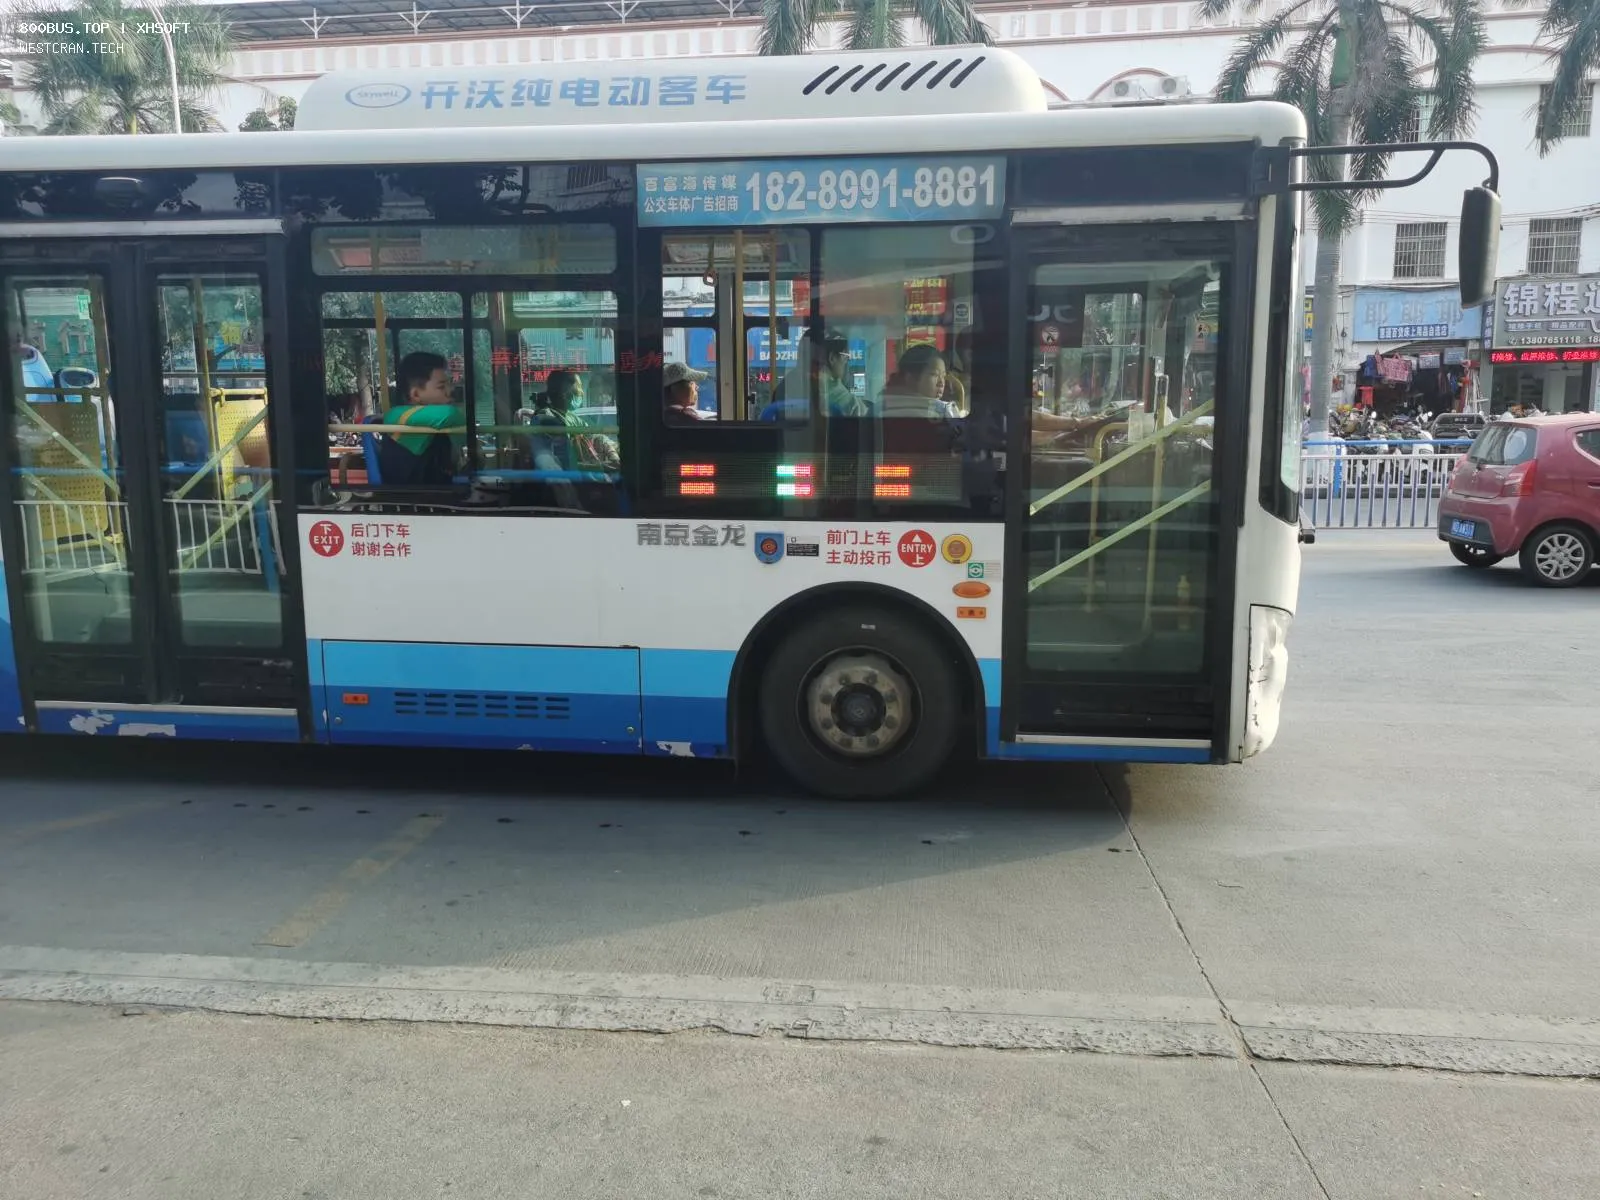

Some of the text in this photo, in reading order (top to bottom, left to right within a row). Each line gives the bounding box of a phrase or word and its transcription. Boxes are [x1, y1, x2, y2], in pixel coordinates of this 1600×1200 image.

[421, 74, 747, 110] 开沃纯电动客车
[745, 164, 996, 212] 182-8991-8881
[644, 195, 739, 213] 公交车体广告招商
[320, 523, 332, 535] 下
[351, 523, 410, 538] 后门下车
[636, 522, 746, 547] 南京金龙
[826, 529, 892, 546] 前门上车
[313, 535, 340, 545] EXIT
[901, 543, 933, 554] ENTRY
[352, 542, 412, 557] 谢谢合作
[826, 549, 892, 566] 主动投币
